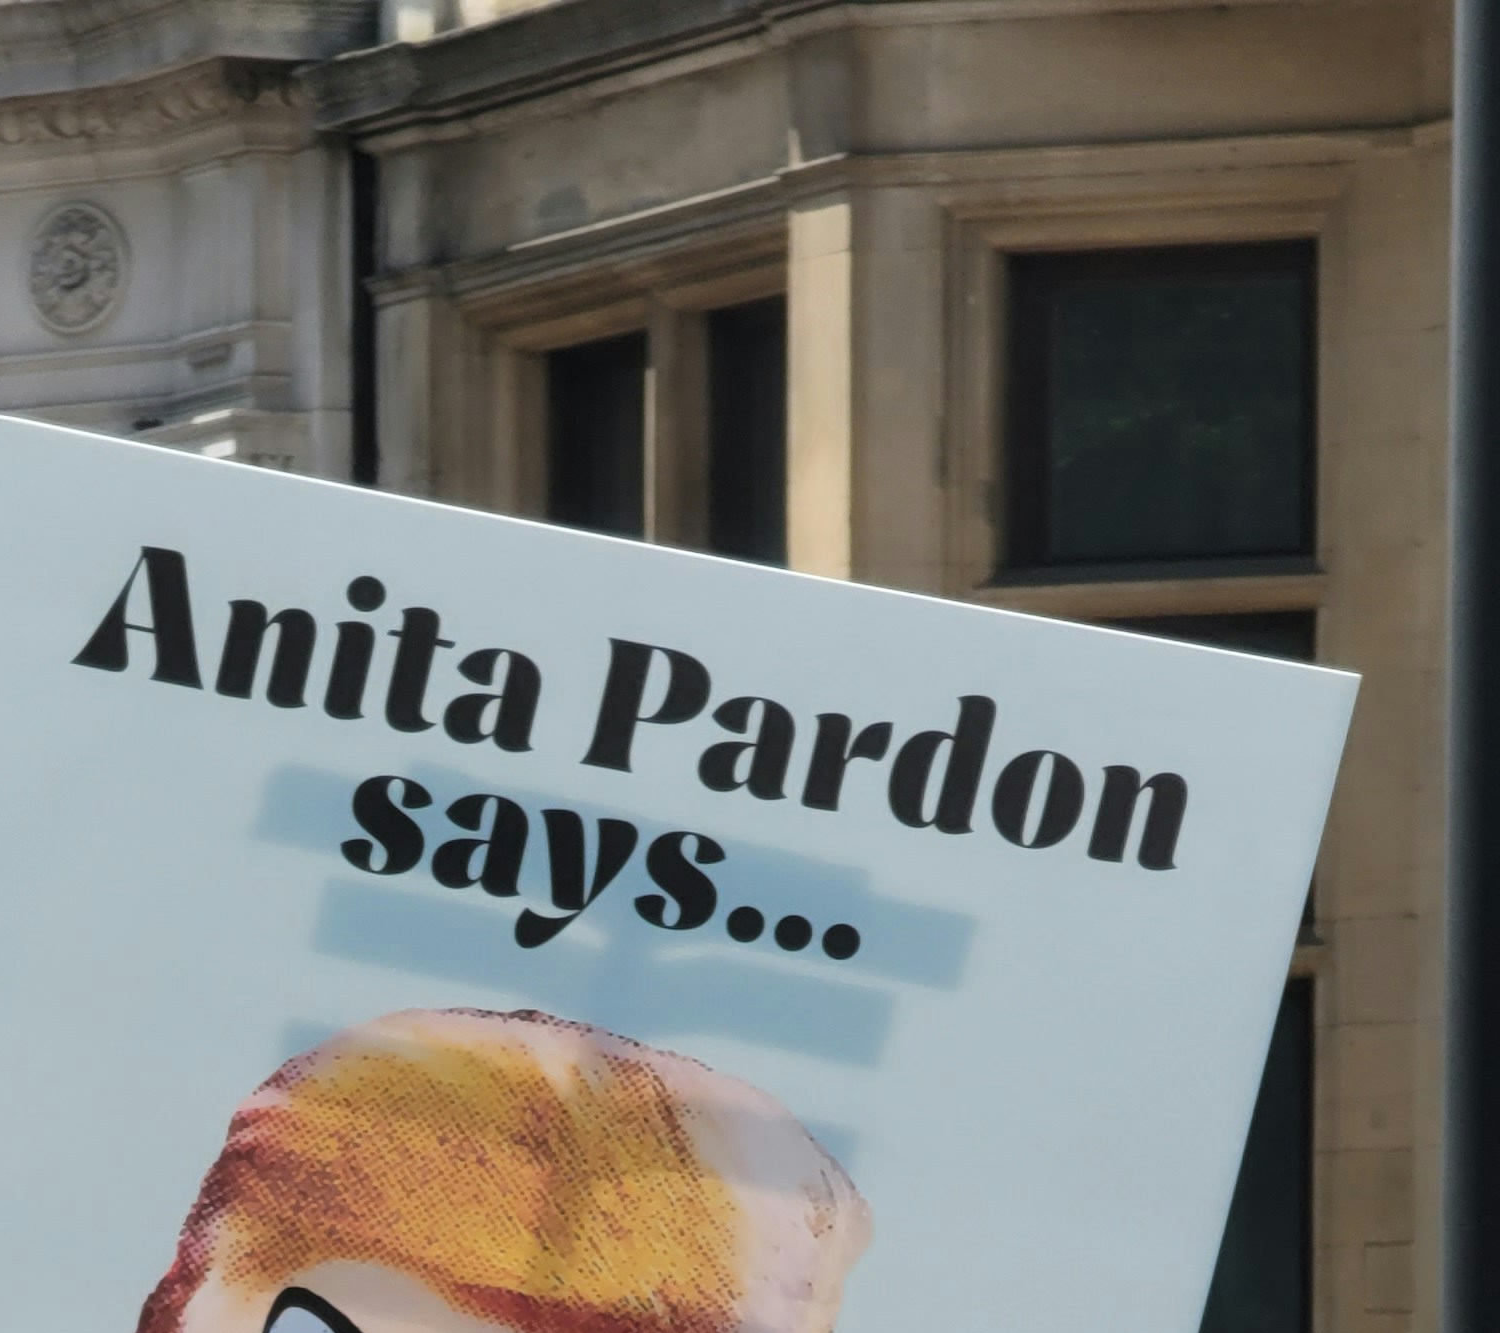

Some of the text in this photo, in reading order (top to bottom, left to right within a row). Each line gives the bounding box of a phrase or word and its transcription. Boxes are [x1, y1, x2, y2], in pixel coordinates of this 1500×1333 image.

[70, 546, 1188, 871] Anita Pardon
[340, 774, 861, 961] says...
